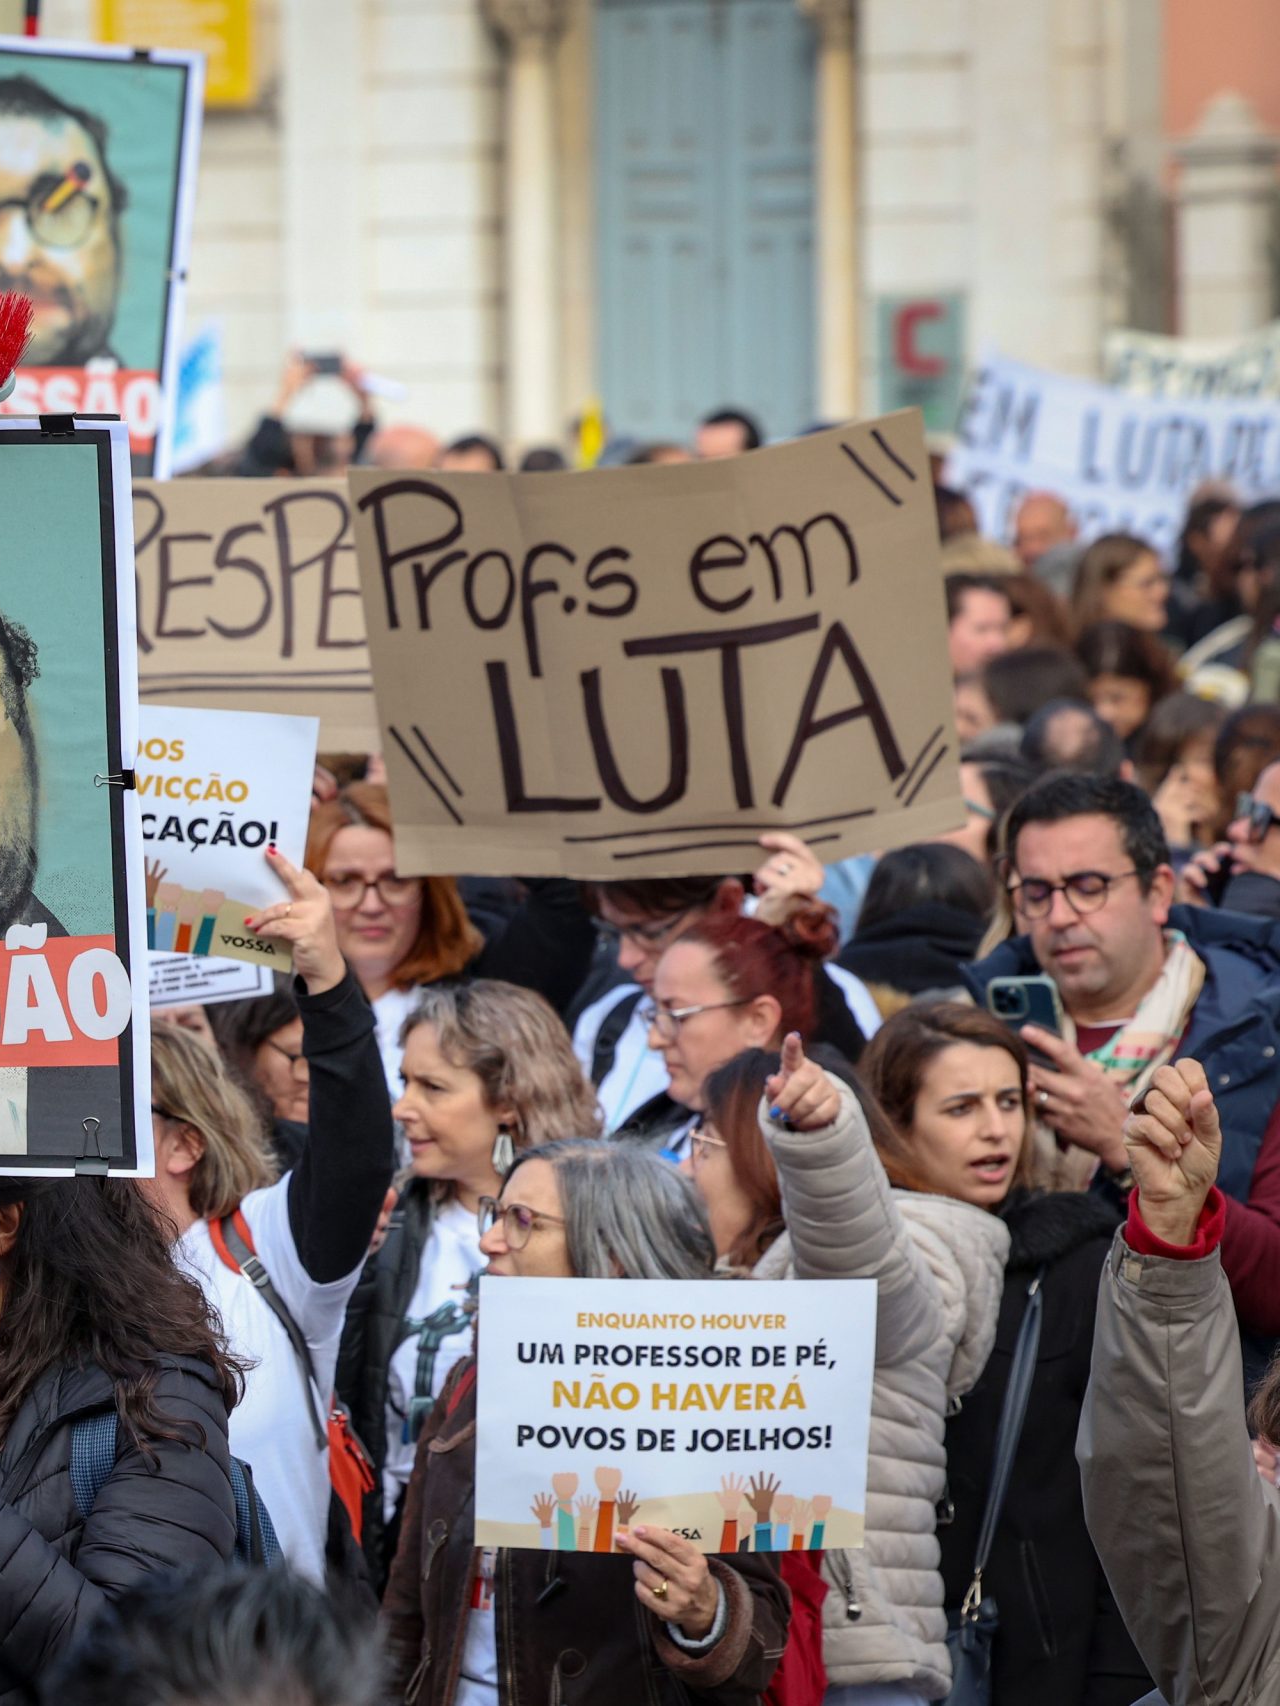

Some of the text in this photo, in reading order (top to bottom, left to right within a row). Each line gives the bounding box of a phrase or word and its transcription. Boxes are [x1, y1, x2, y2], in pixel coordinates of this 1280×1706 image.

[689, 513, 860, 612] em
[485, 613, 908, 814] LUTA
[577, 1312, 786, 1330] ENQUANTO HOUVER
[518, 1338, 836, 1370] UM PROFESSOR DE PÉ,
[553, 1374, 806, 1411] NÃO HAVERÁ
[517, 1425, 832, 1452] POVOS DE JOELHOS!
